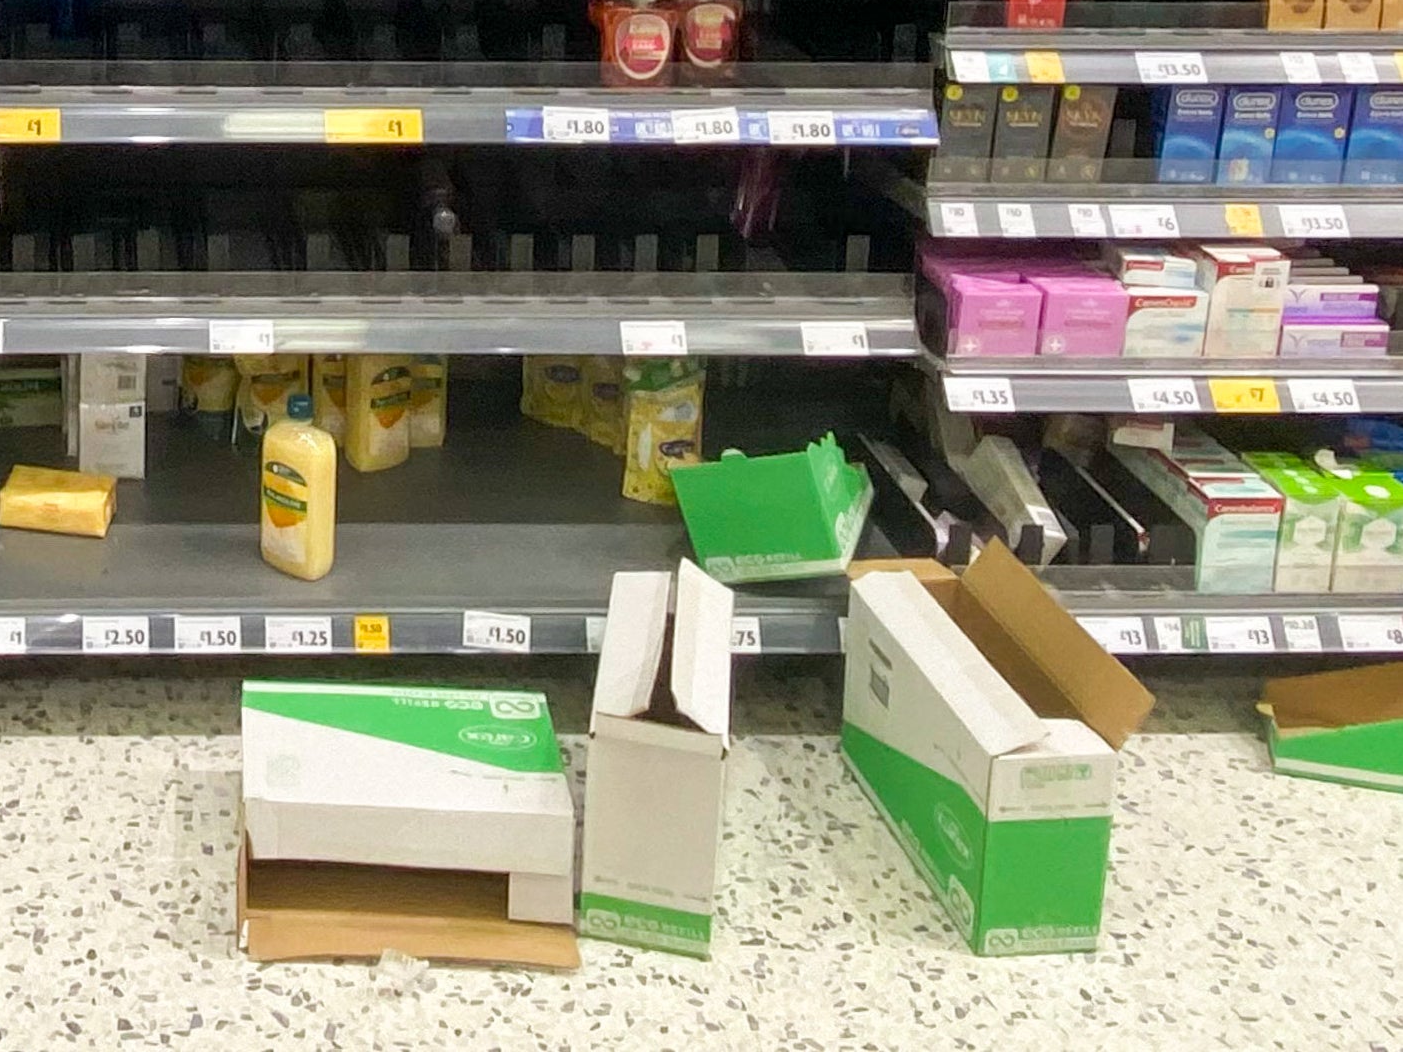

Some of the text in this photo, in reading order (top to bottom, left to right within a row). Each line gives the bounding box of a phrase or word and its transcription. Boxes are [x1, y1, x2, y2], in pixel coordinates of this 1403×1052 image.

[27, 119, 41, 135] £1
[387, 120, 402, 136] £1
[566, 120, 604, 134] £1.80
[696, 121, 732, 135] £1.80
[792, 123, 829, 138] £1.80
[1158, 217, 1174, 231] £6
[1301, 217, 1343, 230] £13.50
[973, 390, 1008, 405] £1.35
[1153, 391, 1193, 405] £4.50
[1313, 391, 1353, 406] £4.50
[10, 631, 21, 643] £1
[105, 630, 145, 644] £2.50
[200, 630, 236, 645] £1.50
[292, 631, 327, 646] £1.25
[489, 628, 525, 644] £1.50
[1120, 630, 1141, 645] £13
[1248, 629, 1269, 645] £13
